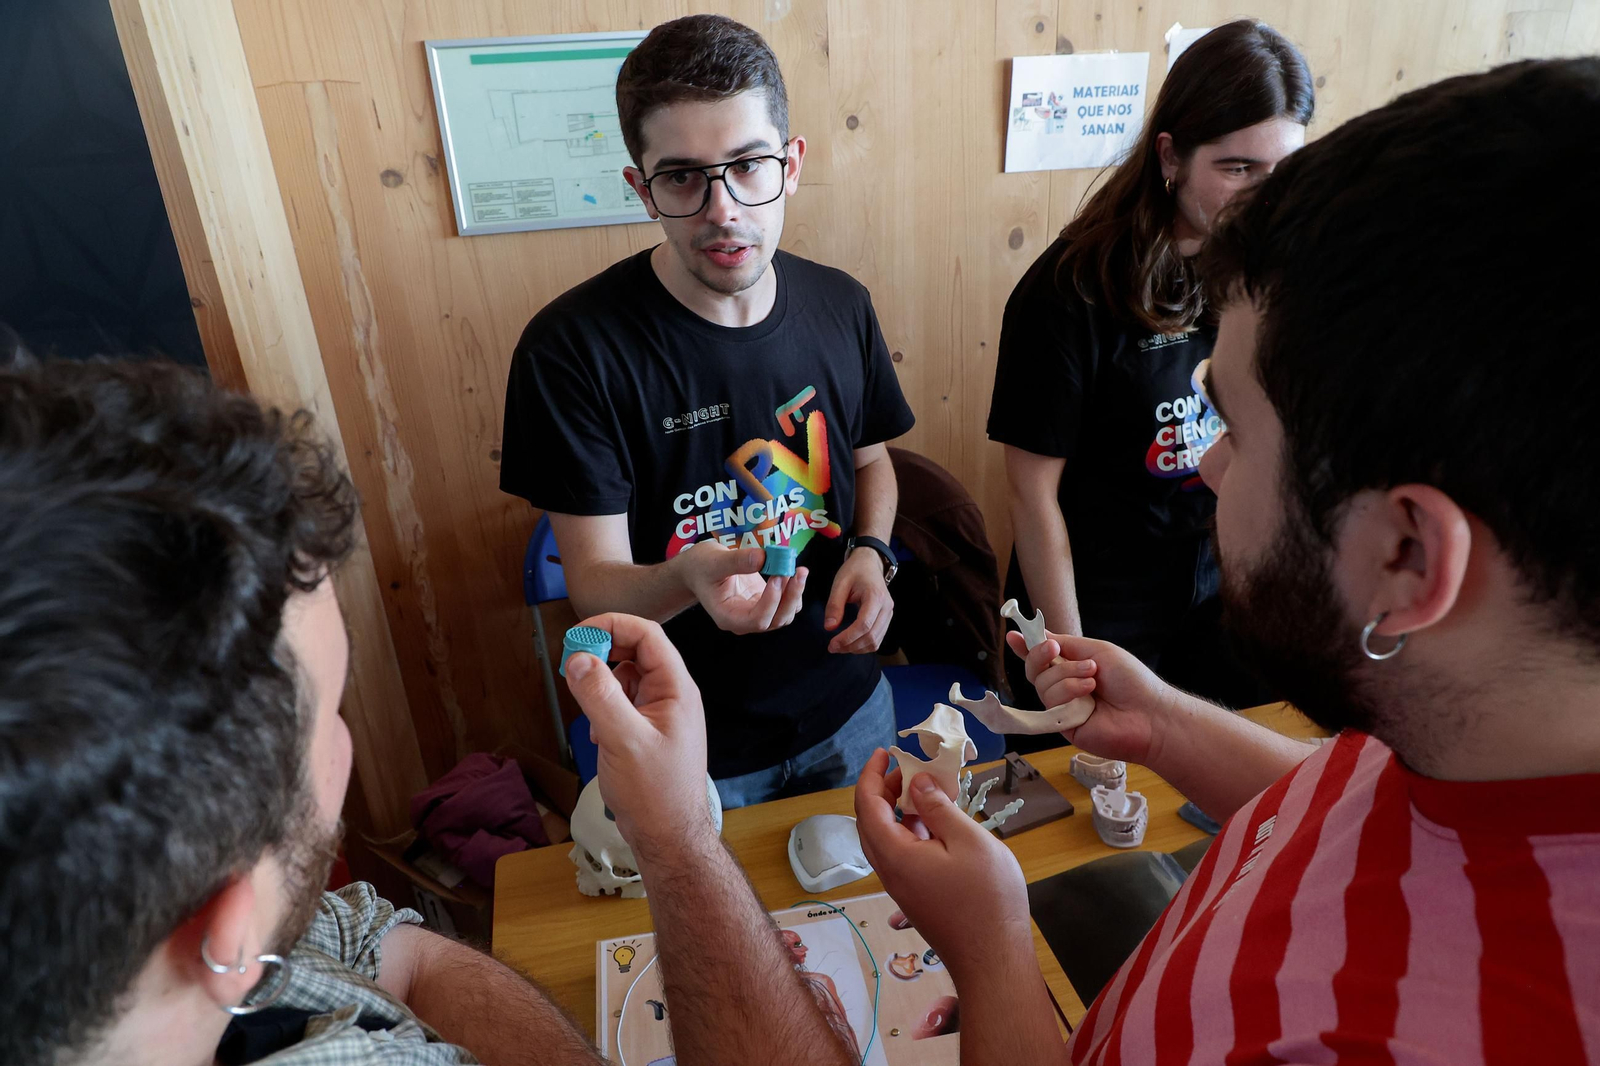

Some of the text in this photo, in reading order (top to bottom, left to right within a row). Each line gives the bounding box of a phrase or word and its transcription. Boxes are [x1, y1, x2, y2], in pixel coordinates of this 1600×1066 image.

[1072, 84, 1140, 99] MATERIAIS
[1077, 103, 1133, 118] QUE NOS
[1081, 123, 1125, 136] SANAN
[662, 403, 730, 429] G-NIGHT
[1155, 394, 1202, 423] CON
[673, 479, 739, 515] CON
[675, 486, 806, 540] CIENCIAS
[679, 509, 829, 551] EATIVAS
